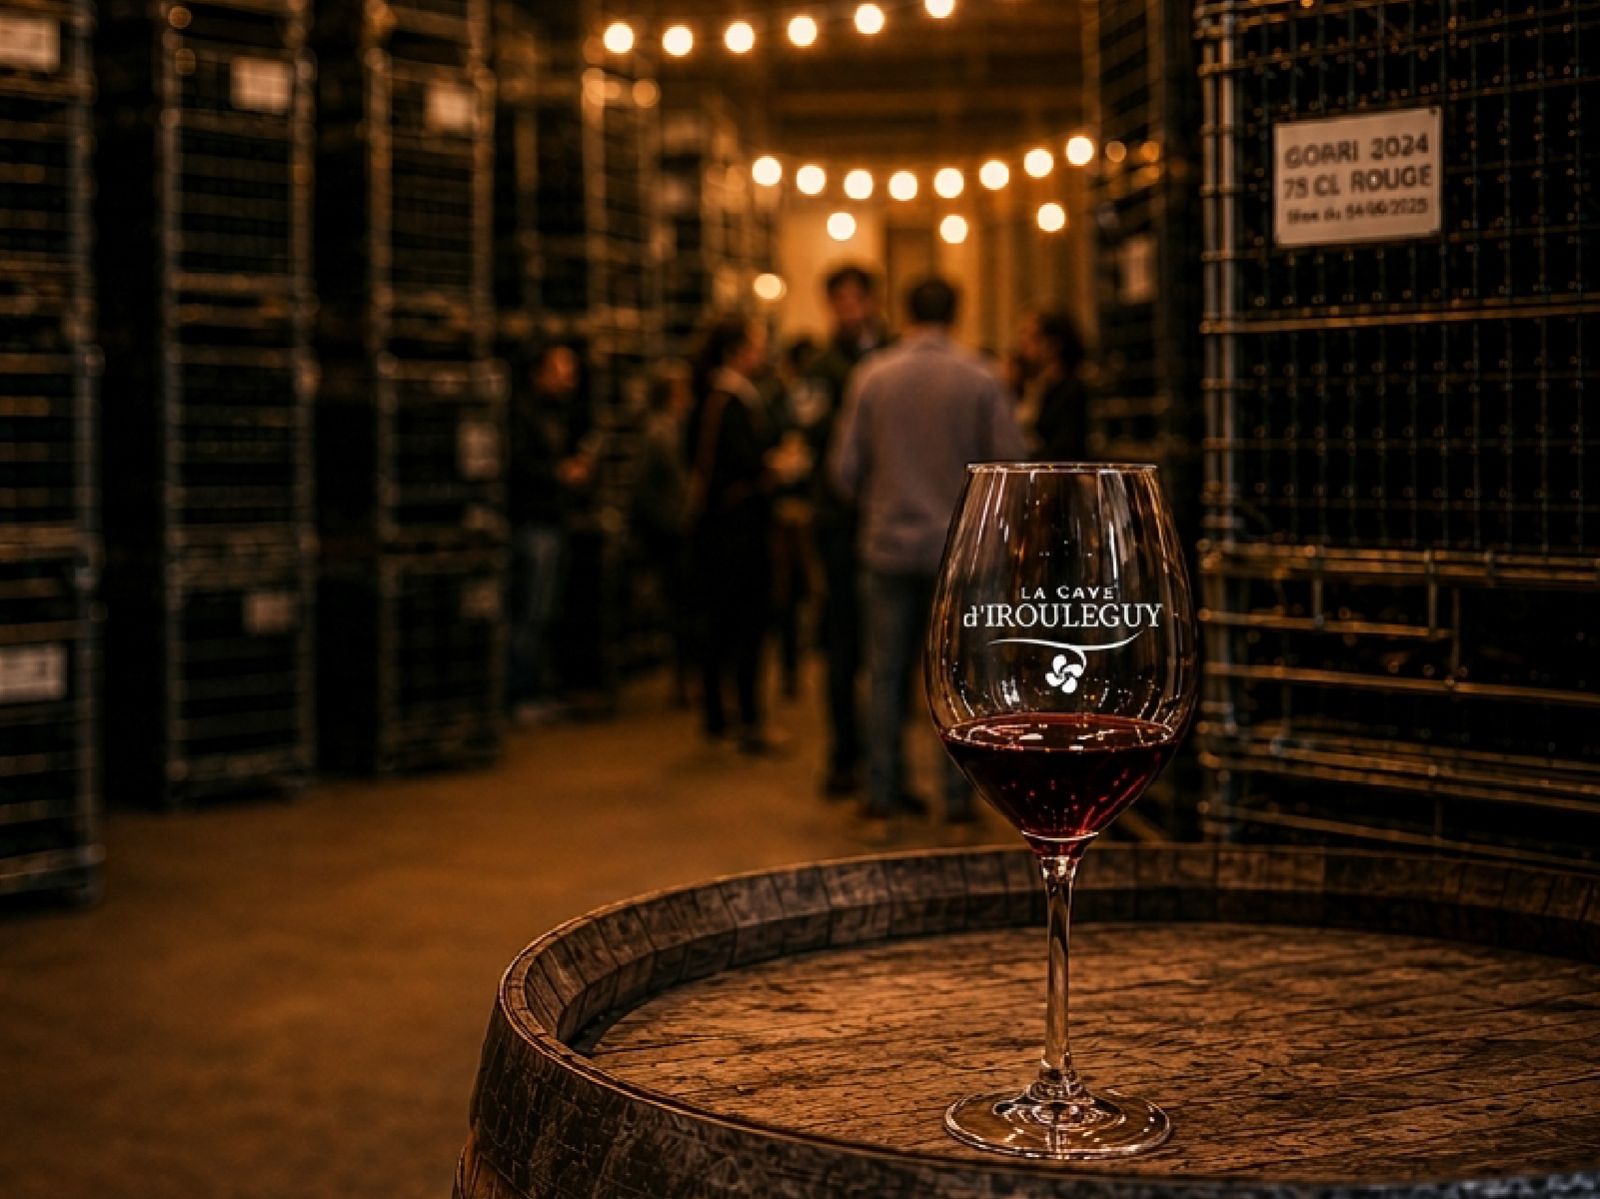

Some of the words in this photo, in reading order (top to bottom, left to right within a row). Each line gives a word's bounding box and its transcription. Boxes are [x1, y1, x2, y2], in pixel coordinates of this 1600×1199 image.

[1370, 133, 1429, 161] 2024
[1284, 177, 1309, 199] 75
[1314, 174, 1341, 195] CL
[1351, 164, 1433, 192] ROUGE
[1021, 586, 1046, 599] LA
[1056, 585, 1115, 599] CAVE
[963, 603, 1163, 628] d'IROULEGUY
